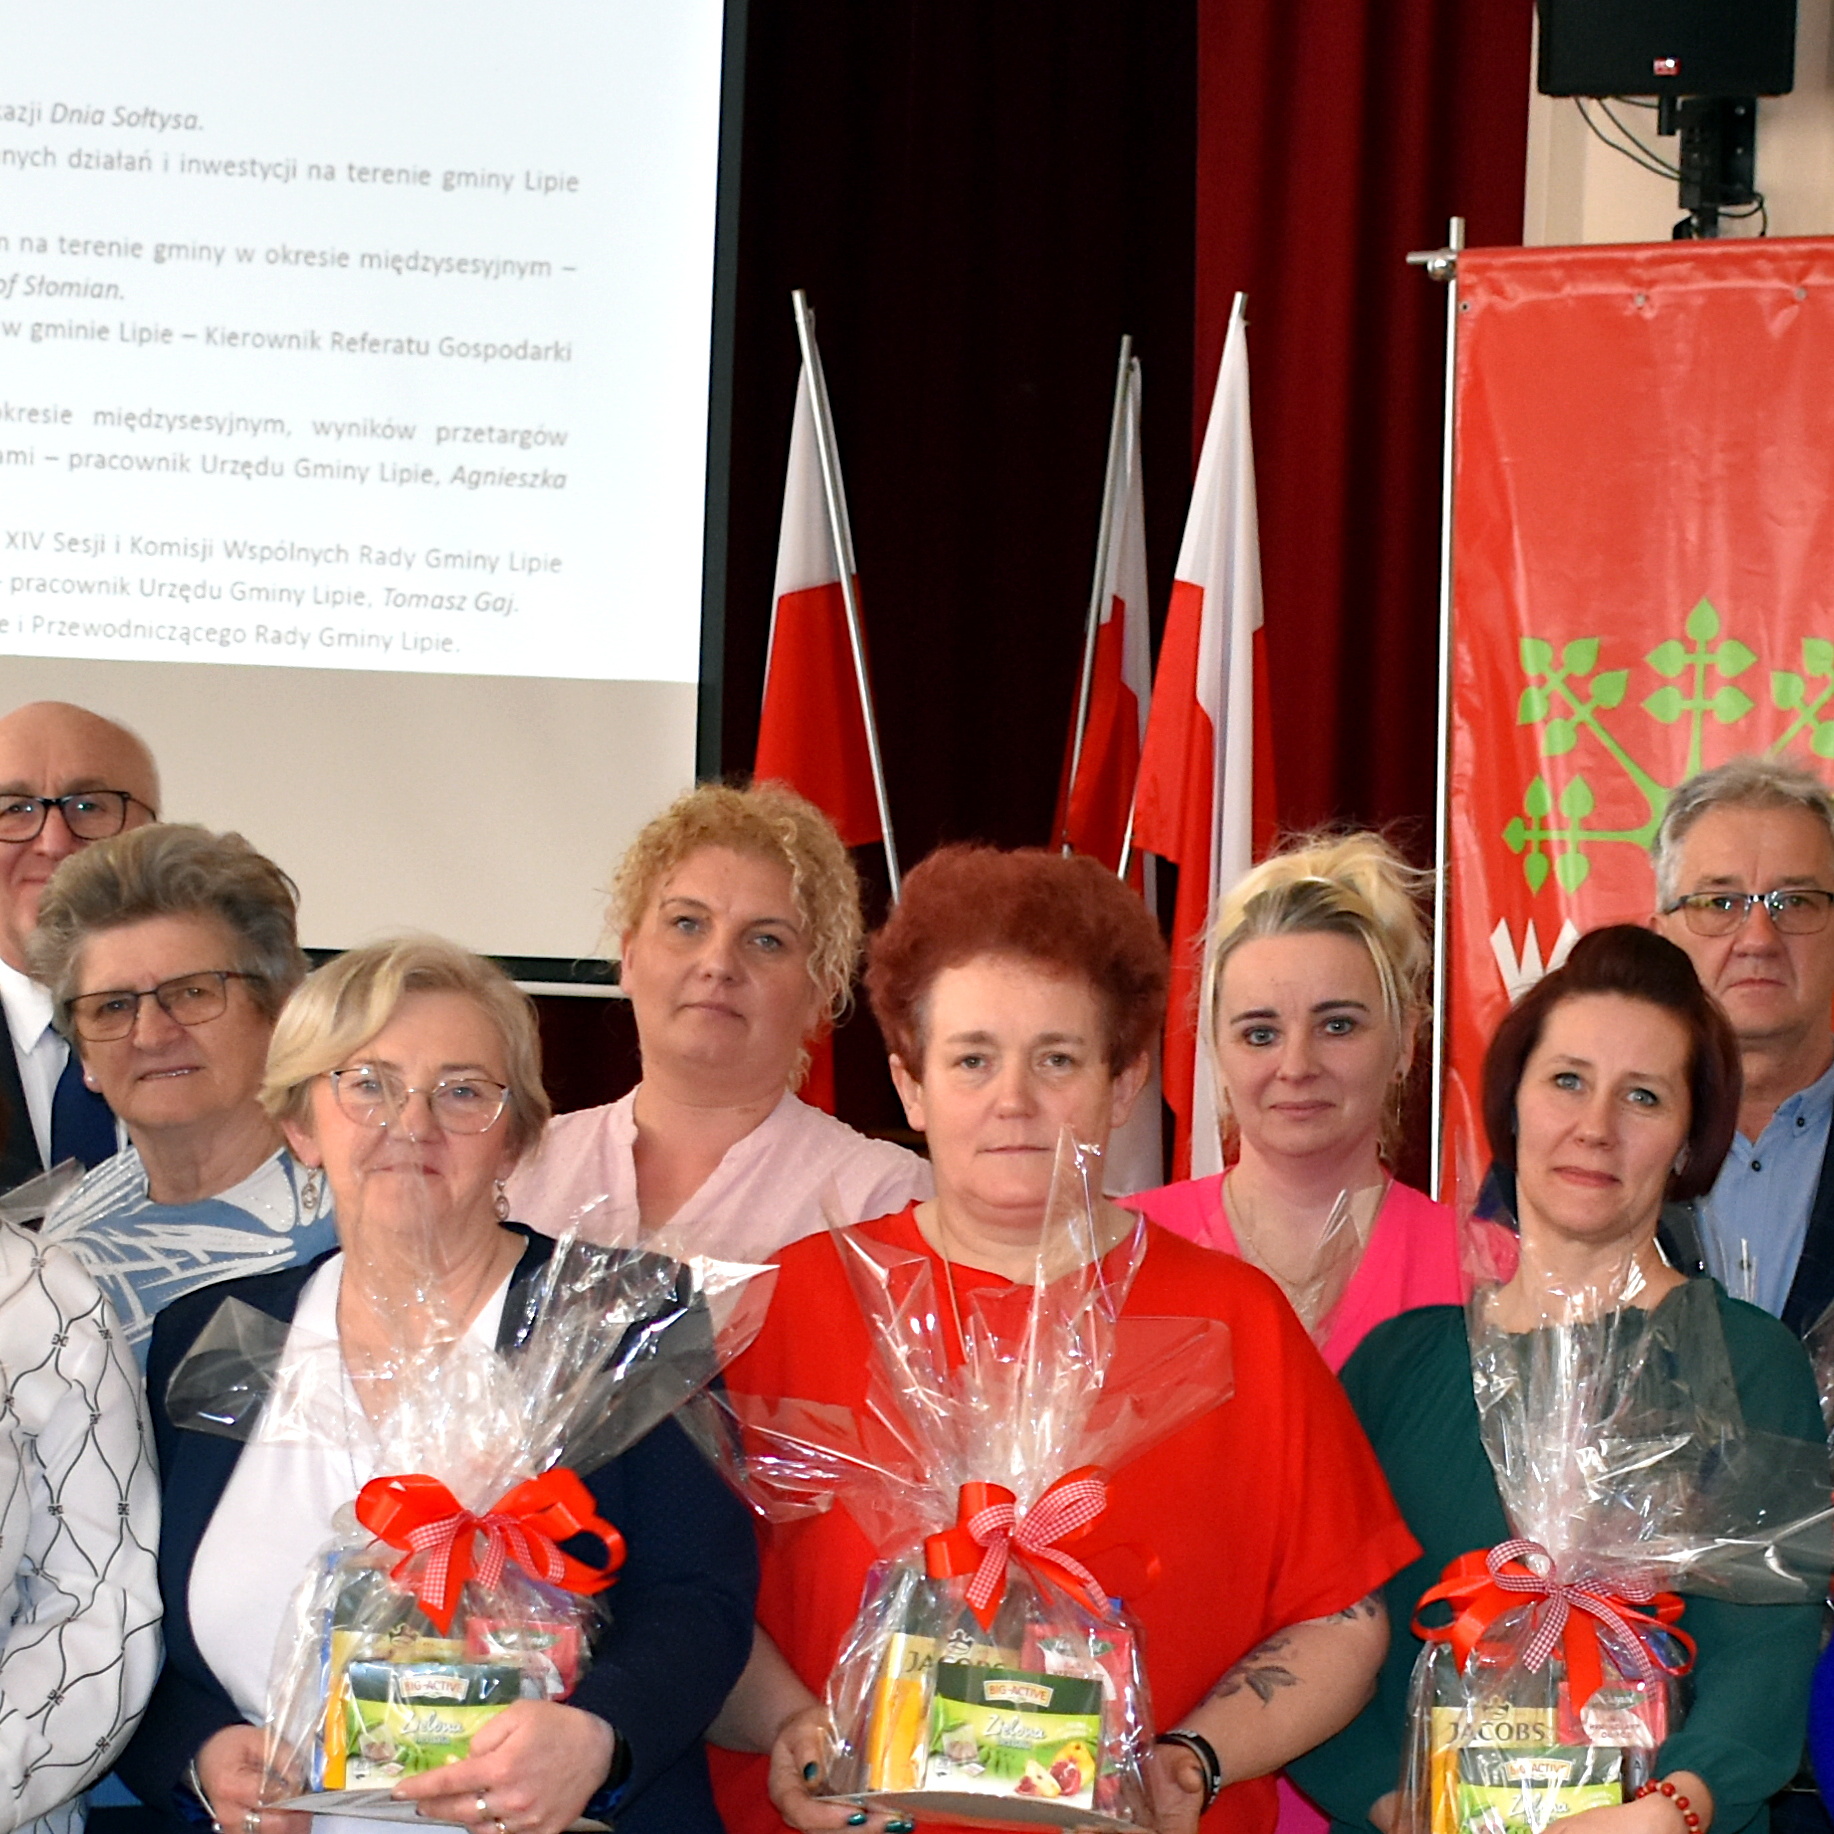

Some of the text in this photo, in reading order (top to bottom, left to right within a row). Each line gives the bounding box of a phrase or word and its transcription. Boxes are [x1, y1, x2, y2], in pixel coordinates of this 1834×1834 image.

[48, 101, 107, 127] Dnia
[66, 146, 154, 173] działań
[179, 153, 298, 185] inwestycji
[306, 162, 337, 183] na
[345, 161, 433, 187] terenie
[440, 168, 516, 195] gminy
[523, 169, 581, 197] Lipie
[18, 235, 49, 255] na
[56, 234, 145, 260] terenie
[151, 241, 227, 268] gminy
[234, 247, 256, 264] w
[263, 242, 351, 270] okresie
[0, 320, 23, 338] w
[28, 319, 111, 345] gminie
[118, 320, 175, 348] Lipie
[204, 325, 322, 352] Kierownik
[329, 329, 431, 357] Referatu
[436, 335, 573, 364] Gospodarki
[311, 416, 418, 442] wyników
[434, 424, 570, 452] przetargów
[67, 451, 192, 474] pracownik
[200, 453, 286, 482] Urzędu
[292, 456, 371, 486] Gminy
[378, 461, 441, 488] Lipie,
[448, 463, 569, 492] Agnieszka
[5, 530, 46, 552] XIV
[52, 530, 107, 559] Sesji
[129, 535, 214, 564] Komisji
[222, 539, 350, 568] Wspólnych
[358, 543, 417, 571] Rady
[424, 546, 501, 576] Gminy
[508, 551, 564, 577] Lipie
[9, 575, 131, 597] pracownik
[138, 577, 223, 605] Urzędu
[228, 580, 306, 608] Gminy
[312, 584, 373, 609] Lipie,
[383, 586, 469, 613] Tomasz
[472, 590, 519, 618] Gaj.
[254, 623, 312, 650] Rady
[317, 625, 394, 653] Gminy
[400, 631, 460, 655] Lipie.
[988, 1682, 1049, 1702] BIG-ACTIVE
